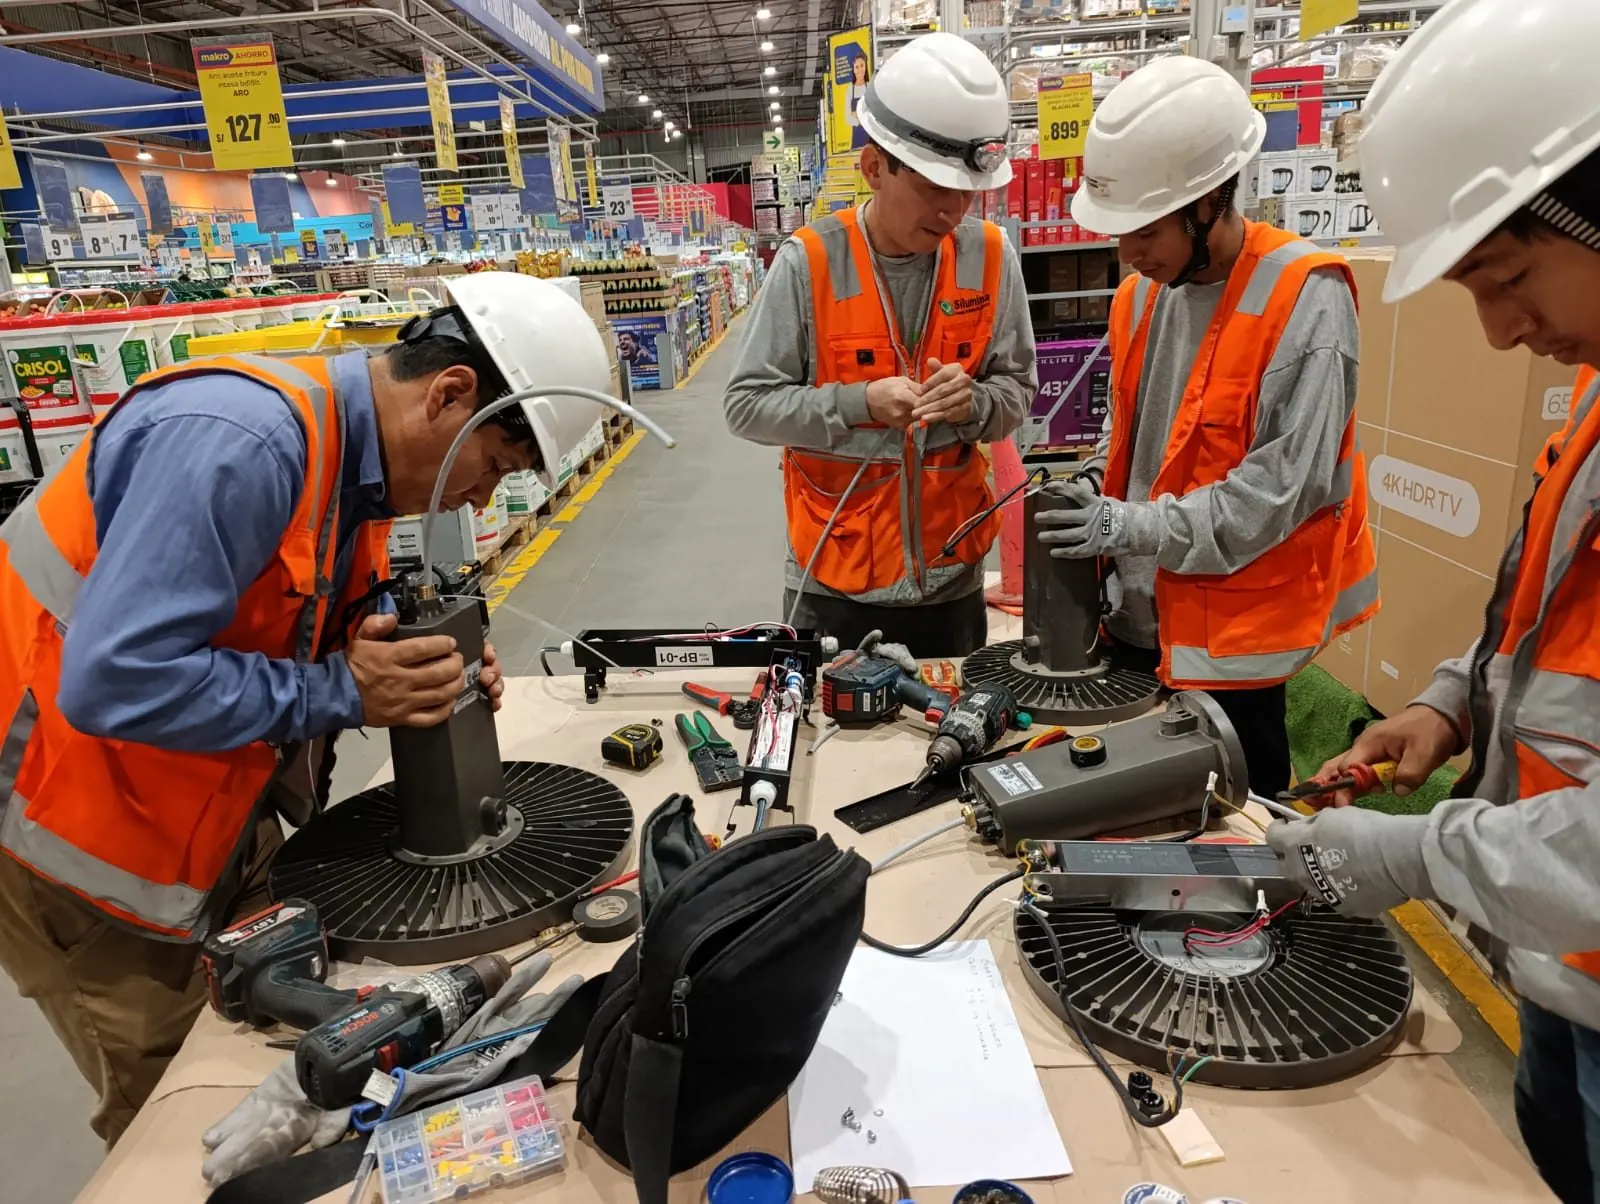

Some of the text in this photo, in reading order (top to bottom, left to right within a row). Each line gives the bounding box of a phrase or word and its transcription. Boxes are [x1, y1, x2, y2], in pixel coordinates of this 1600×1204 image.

[201, 51, 268, 62] makro AHORRO
[225, 113, 262, 143] 127
[1051, 120, 1079, 140] 899
[610, 201, 626, 216] 23
[52, 239, 61, 256] 9
[91, 237, 101, 253] 8
[119, 234, 128, 251] 7
[954, 293, 991, 310] Silumina
[14, 360, 67, 377] CRISOL
[660, 652, 697, 664] BP-01
[252, 915, 276, 933] 18V
[341, 1010, 381, 1036] BOSCH
